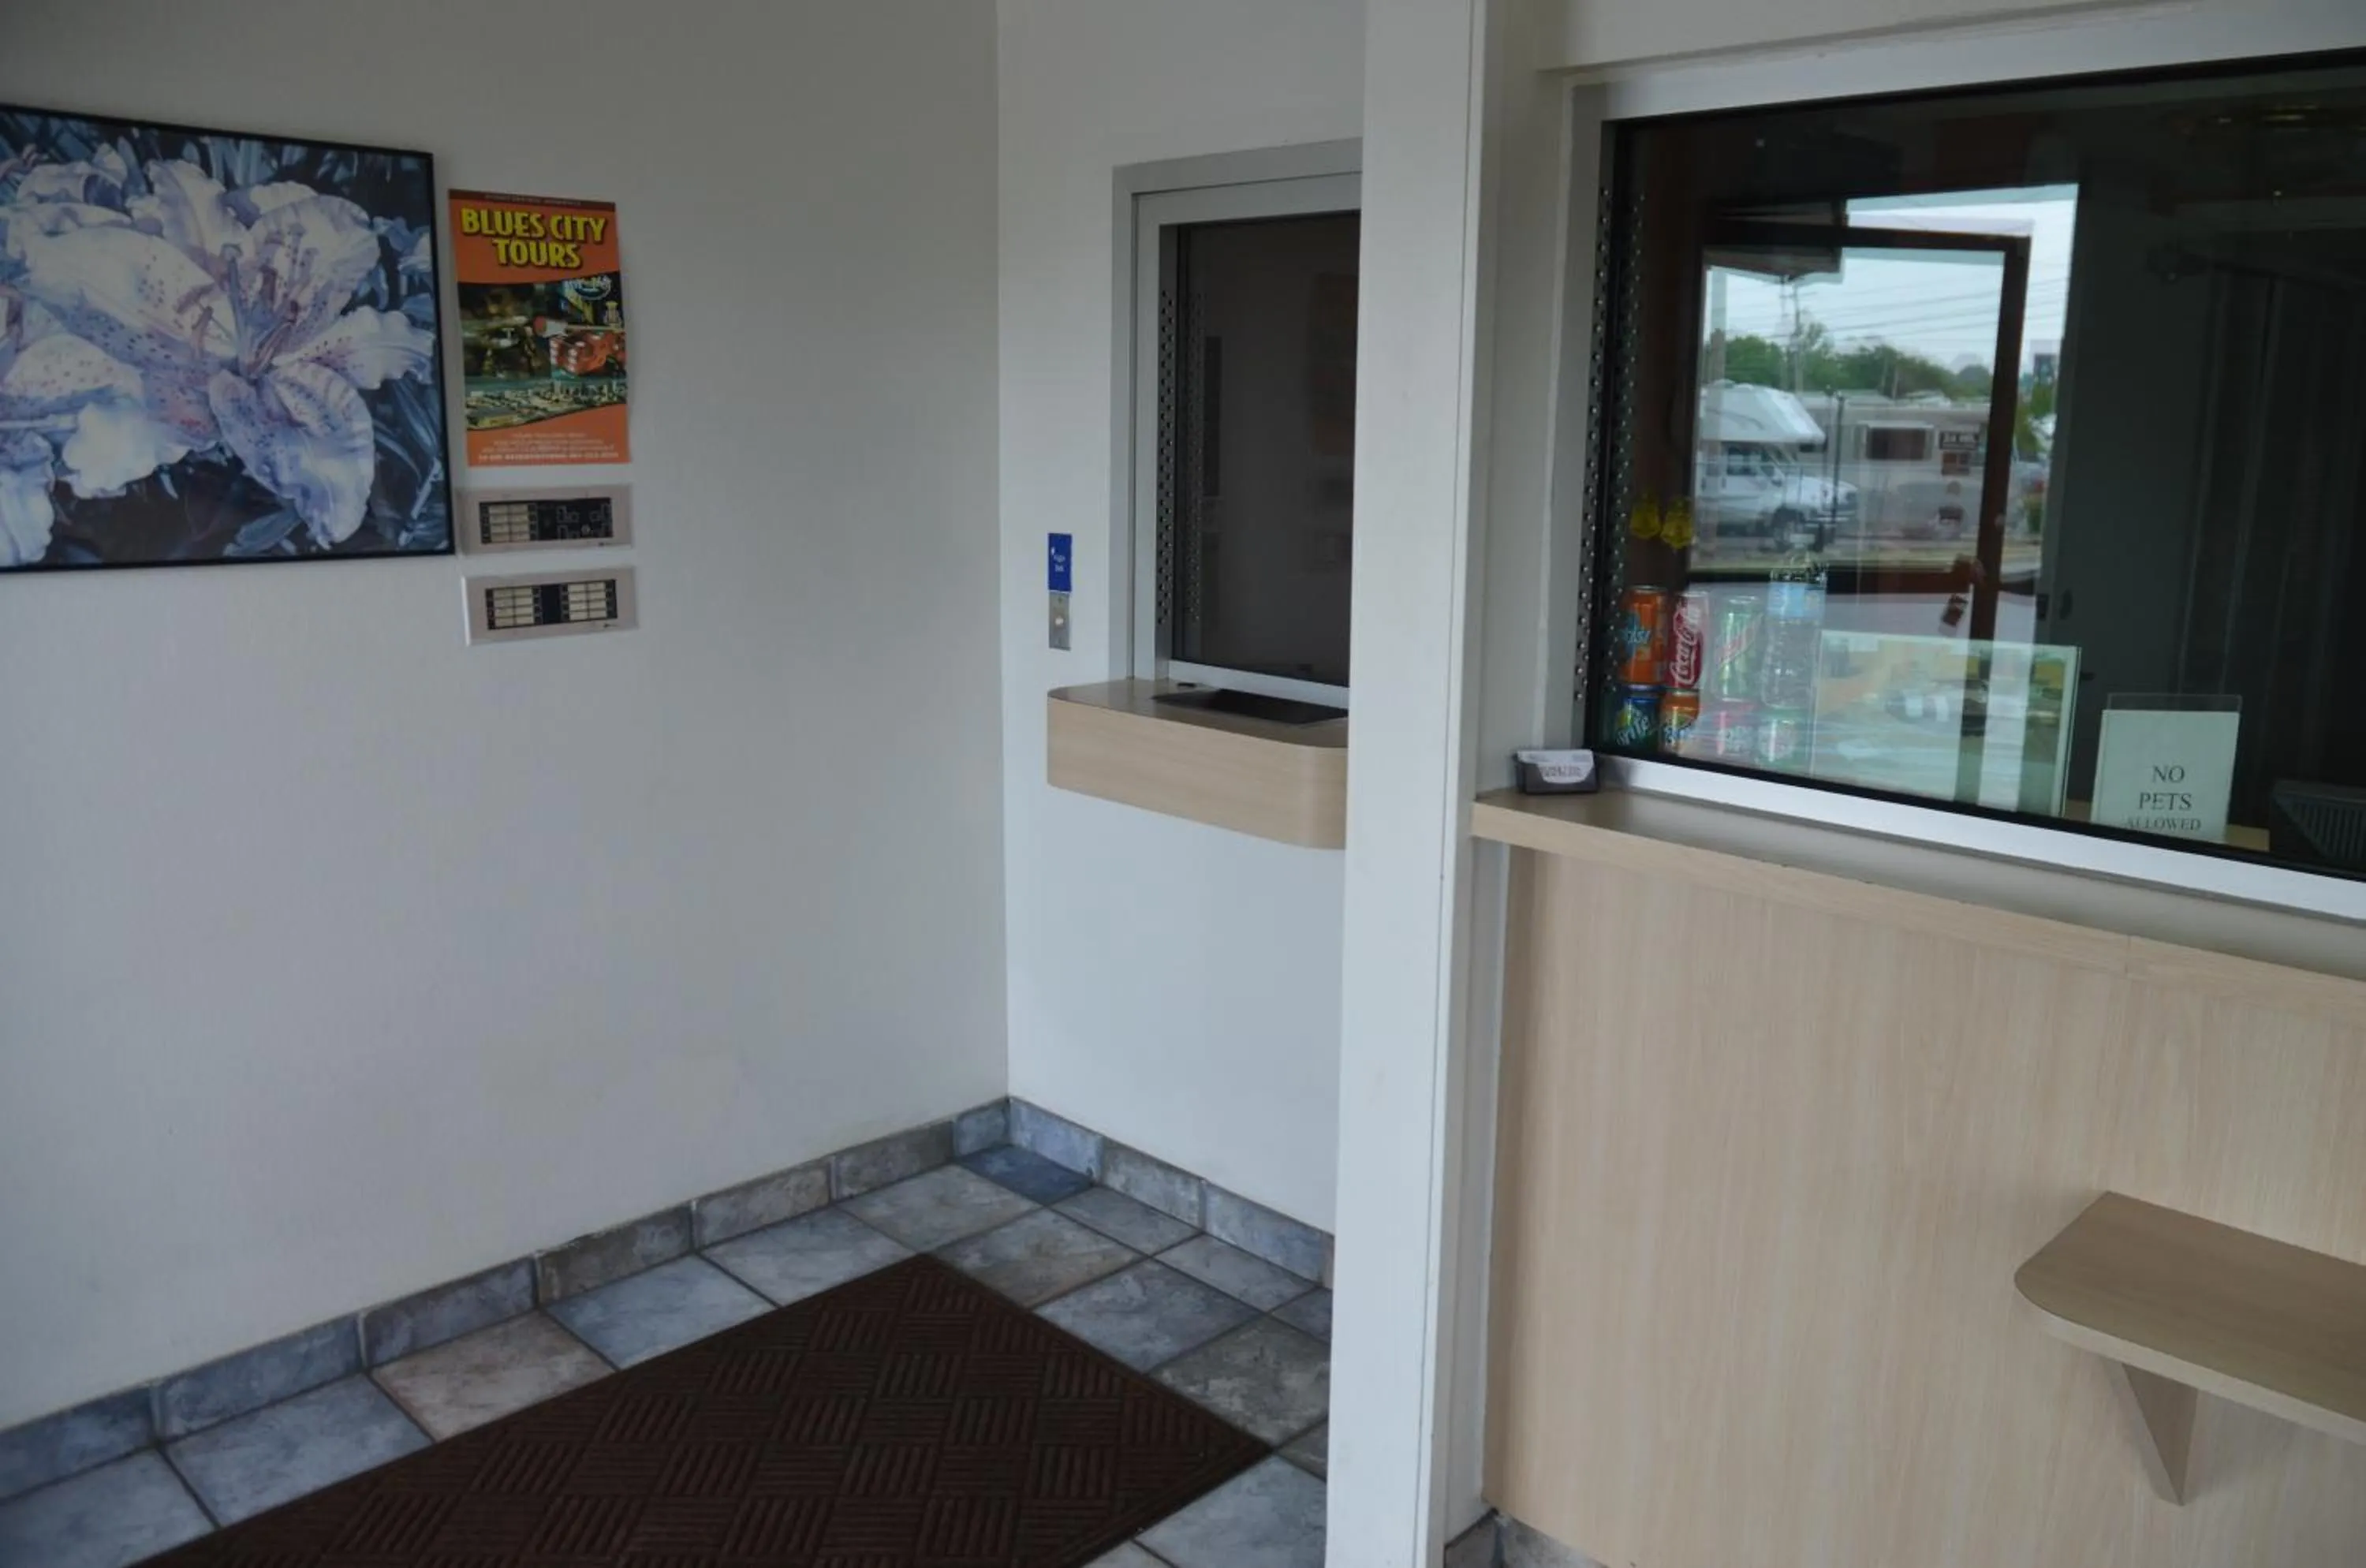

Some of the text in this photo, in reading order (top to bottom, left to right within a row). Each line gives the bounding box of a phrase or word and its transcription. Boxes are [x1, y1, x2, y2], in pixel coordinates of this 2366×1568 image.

[461, 207, 606, 242] BLUES CITY
[493, 239, 581, 268] TOURS
[2152, 765, 2185, 782] NO
[2138, 793, 2192, 811] PETS
[2124, 816, 2201, 831] ALLOWED
